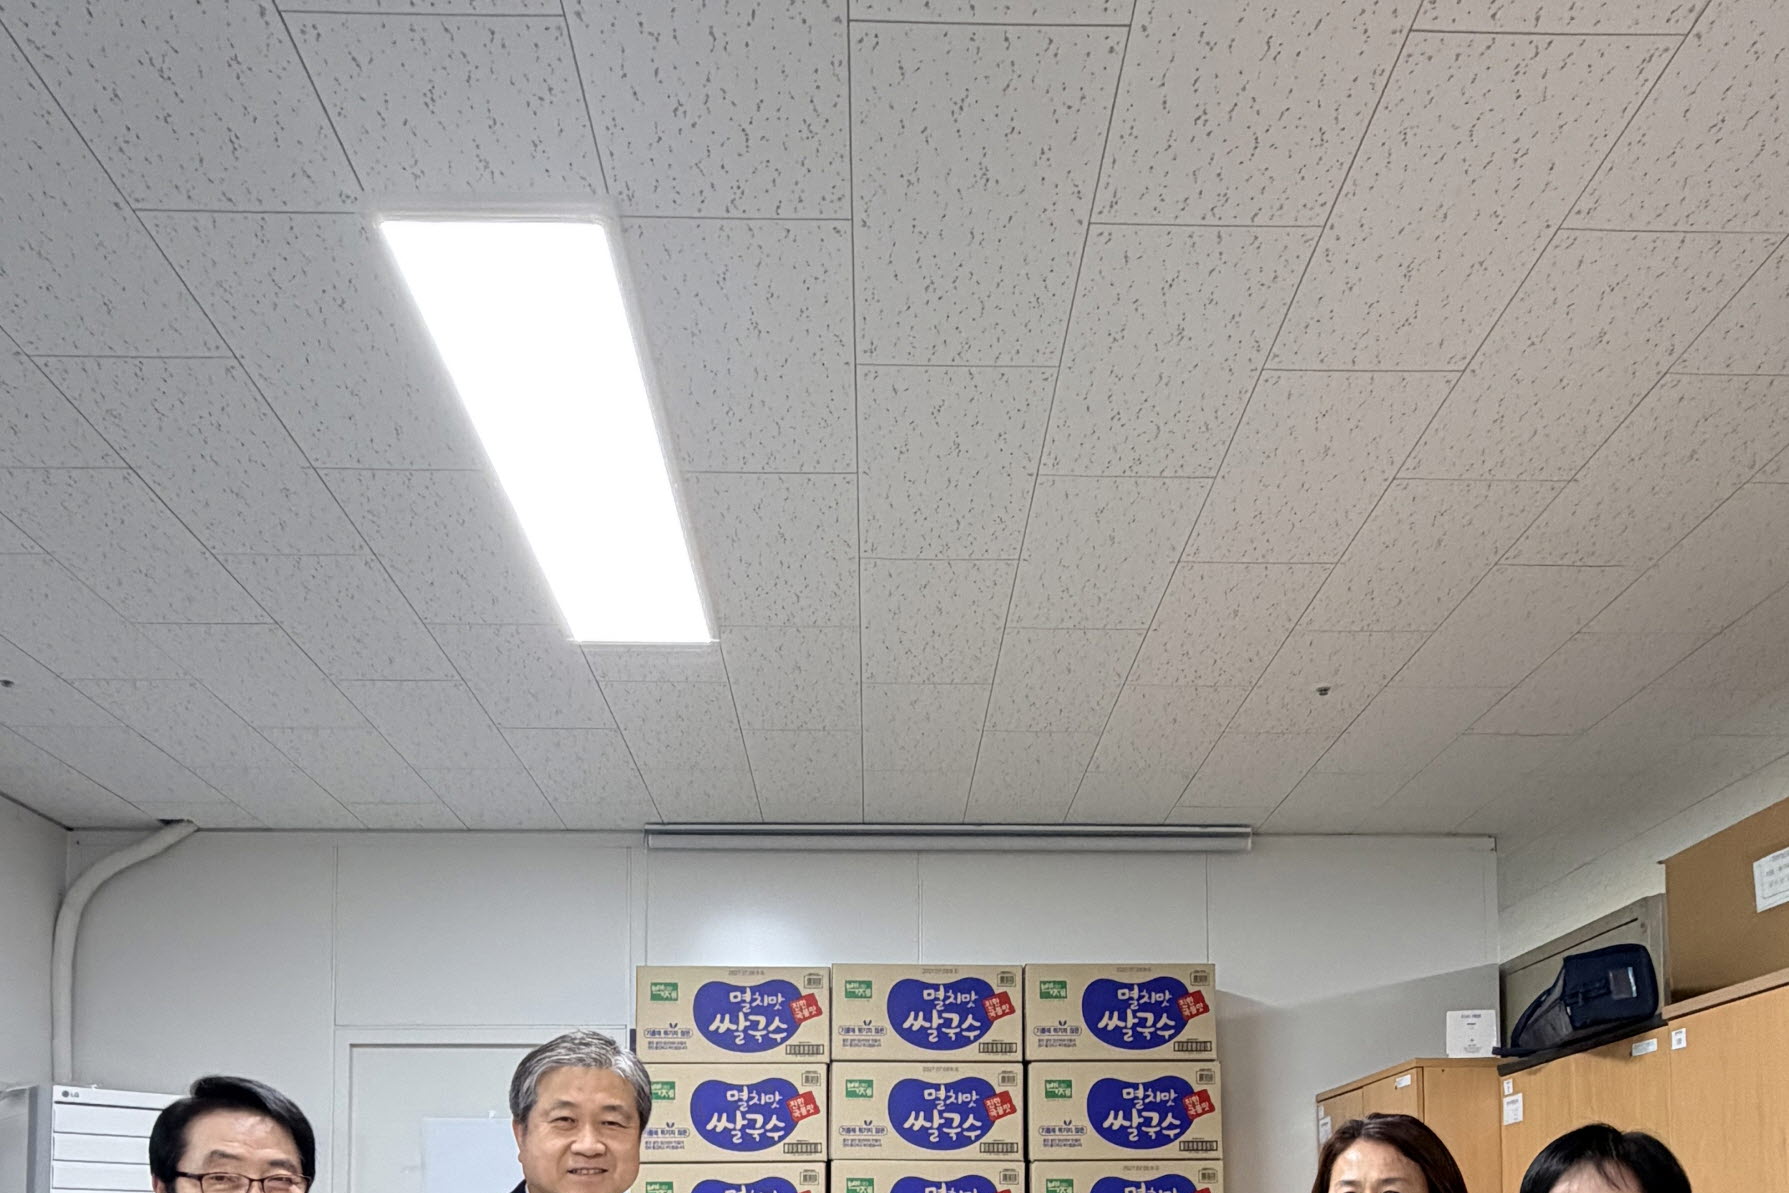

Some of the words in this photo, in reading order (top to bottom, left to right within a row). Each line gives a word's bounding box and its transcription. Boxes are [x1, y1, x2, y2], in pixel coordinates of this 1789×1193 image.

[729, 986, 785, 1012] 멸치맛
[923, 984, 978, 1010] 멸치맛
[1117, 984, 1172, 1009] 멸치맛
[709, 1011, 787, 1044] 쌀국수
[902, 1009, 980, 1042] 쌀국수
[1097, 1008, 1175, 1042] 쌀국수
[726, 1085, 782, 1111] 멸치맛
[923, 1084, 979, 1110] 멸치맛
[1122, 1083, 1177, 1109] 멸치맛
[706, 1110, 785, 1143] 쌀국수
[903, 1109, 981, 1142] 쌀국수
[1103, 1108, 1180, 1141] 쌀국수
